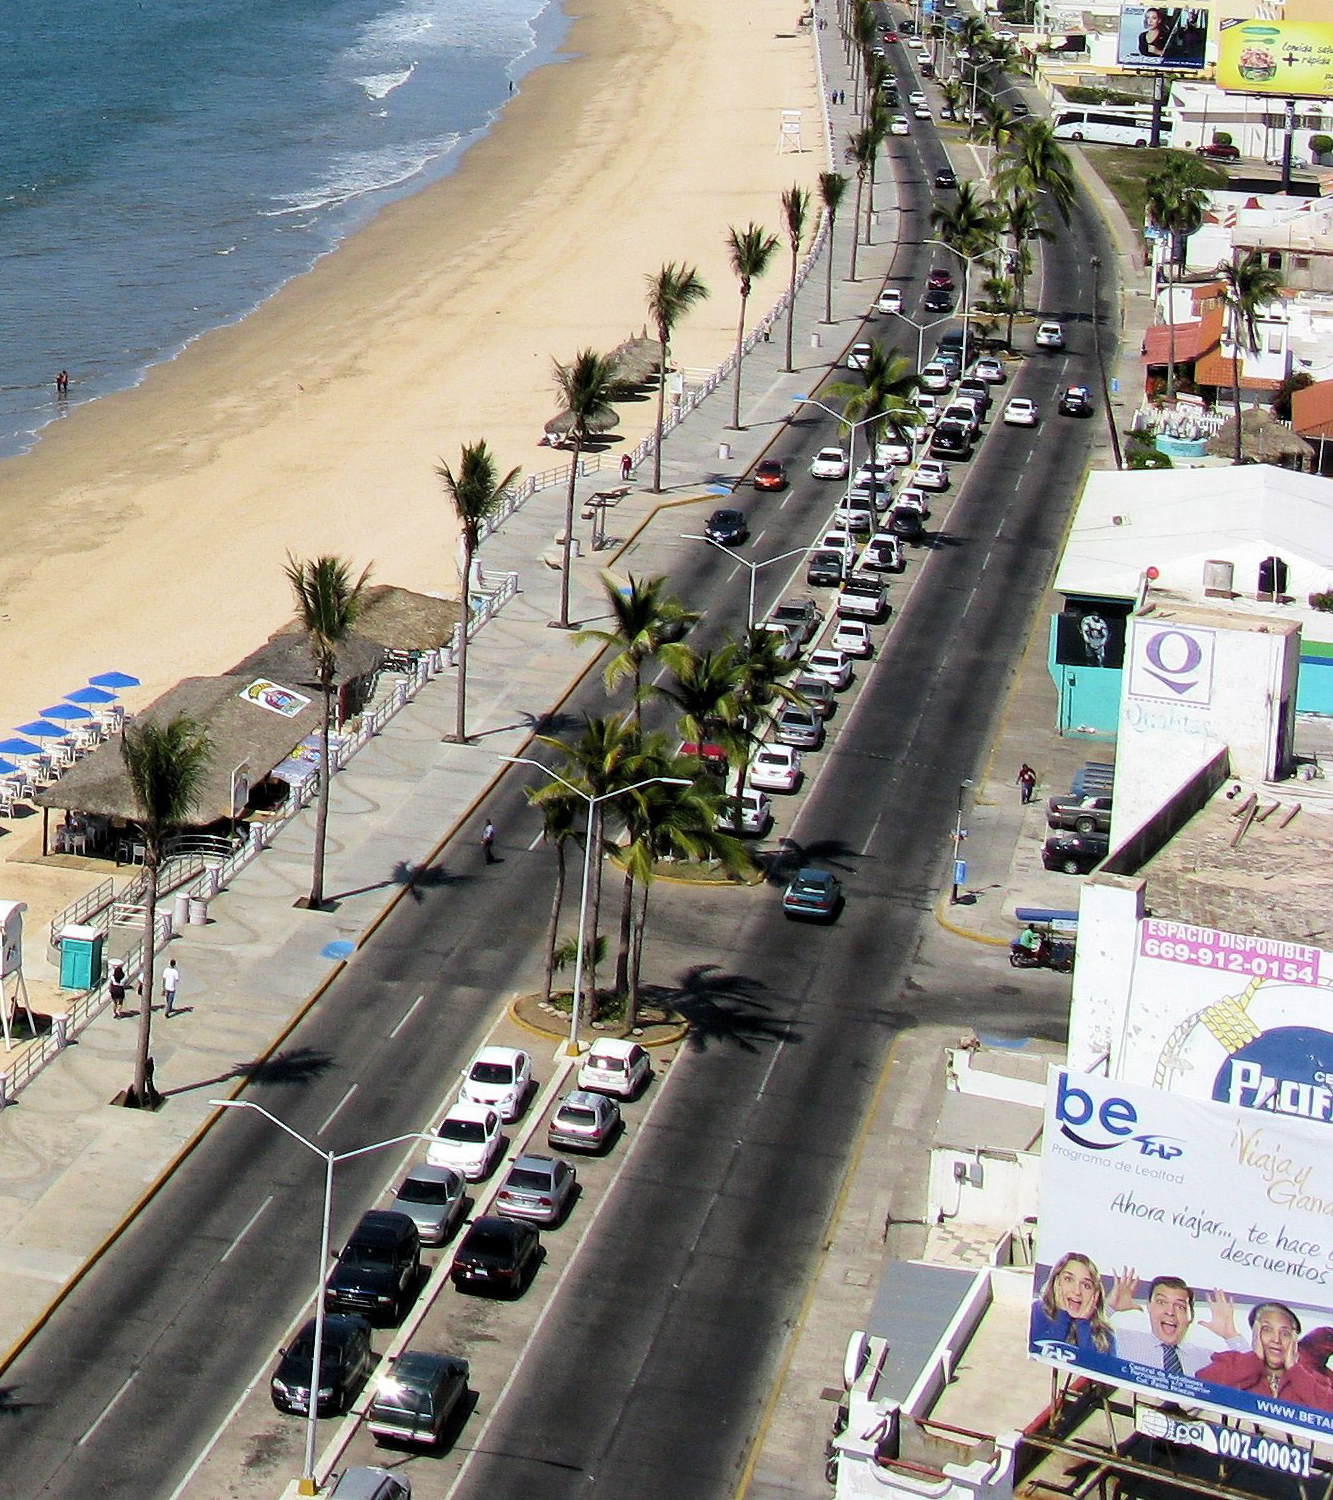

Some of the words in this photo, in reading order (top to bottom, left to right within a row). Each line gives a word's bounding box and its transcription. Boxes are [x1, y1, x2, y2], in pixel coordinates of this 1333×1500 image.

[1141, 630, 1202, 694] Q
[1144, 938, 1314, 984] 669-912-0154
[1147, 920, 1214, 946] ESPACIO
[1219, 931, 1314, 963] DISPONIBLE
[1056, 1072, 1137, 1135] be
[1229, 1058, 1333, 1123] PACIF
[1051, 1142, 1112, 1168] Programa
[1114, 1160, 1132, 1173] de
[1135, 1164, 1185, 1185] Lealtad
[1140, 1139, 1183, 1161] TAP
[1293, 1166, 1313, 1195] y
[1109, 1190, 1165, 1222] Ahora
[1172, 1206, 1233, 1239] viajar...
[1247, 1222, 1269, 1245] te
[1275, 1224, 1321, 1257] hace
[1220, 1238, 1327, 1284] descuentos
[1041, 1344, 1077, 1363] TAP
[1218, 1431, 1311, 1478] 007-00031
